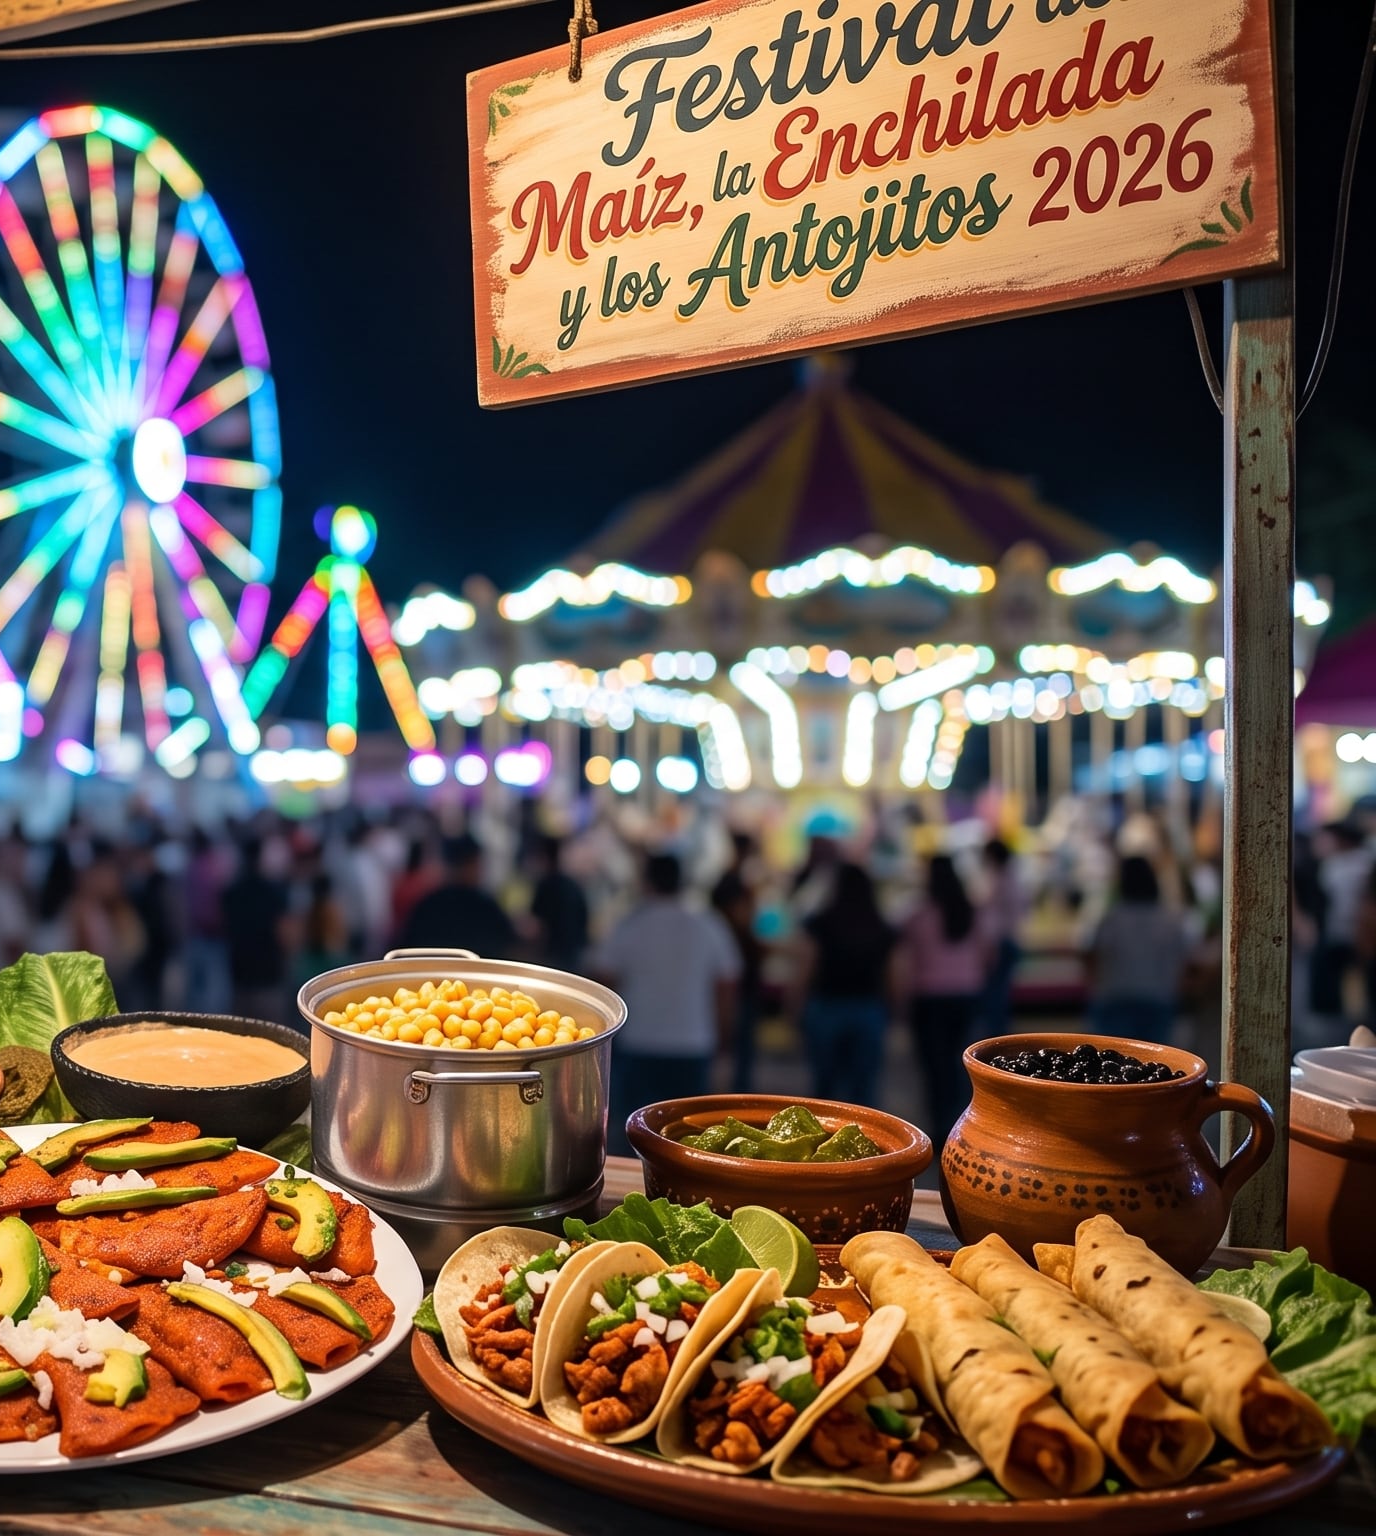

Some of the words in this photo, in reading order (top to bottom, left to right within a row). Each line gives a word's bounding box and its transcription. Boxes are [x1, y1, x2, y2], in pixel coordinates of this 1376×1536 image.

[509, 156, 704, 276] Maíz,
[712, 149, 756, 203] la
[761, 18, 1165, 201] Enchilada
[557, 280, 591, 351] y
[599, 254, 671, 318] los
[677, 172, 1014, 319] Antojitos
[1027, 107, 1214, 227] 2026
